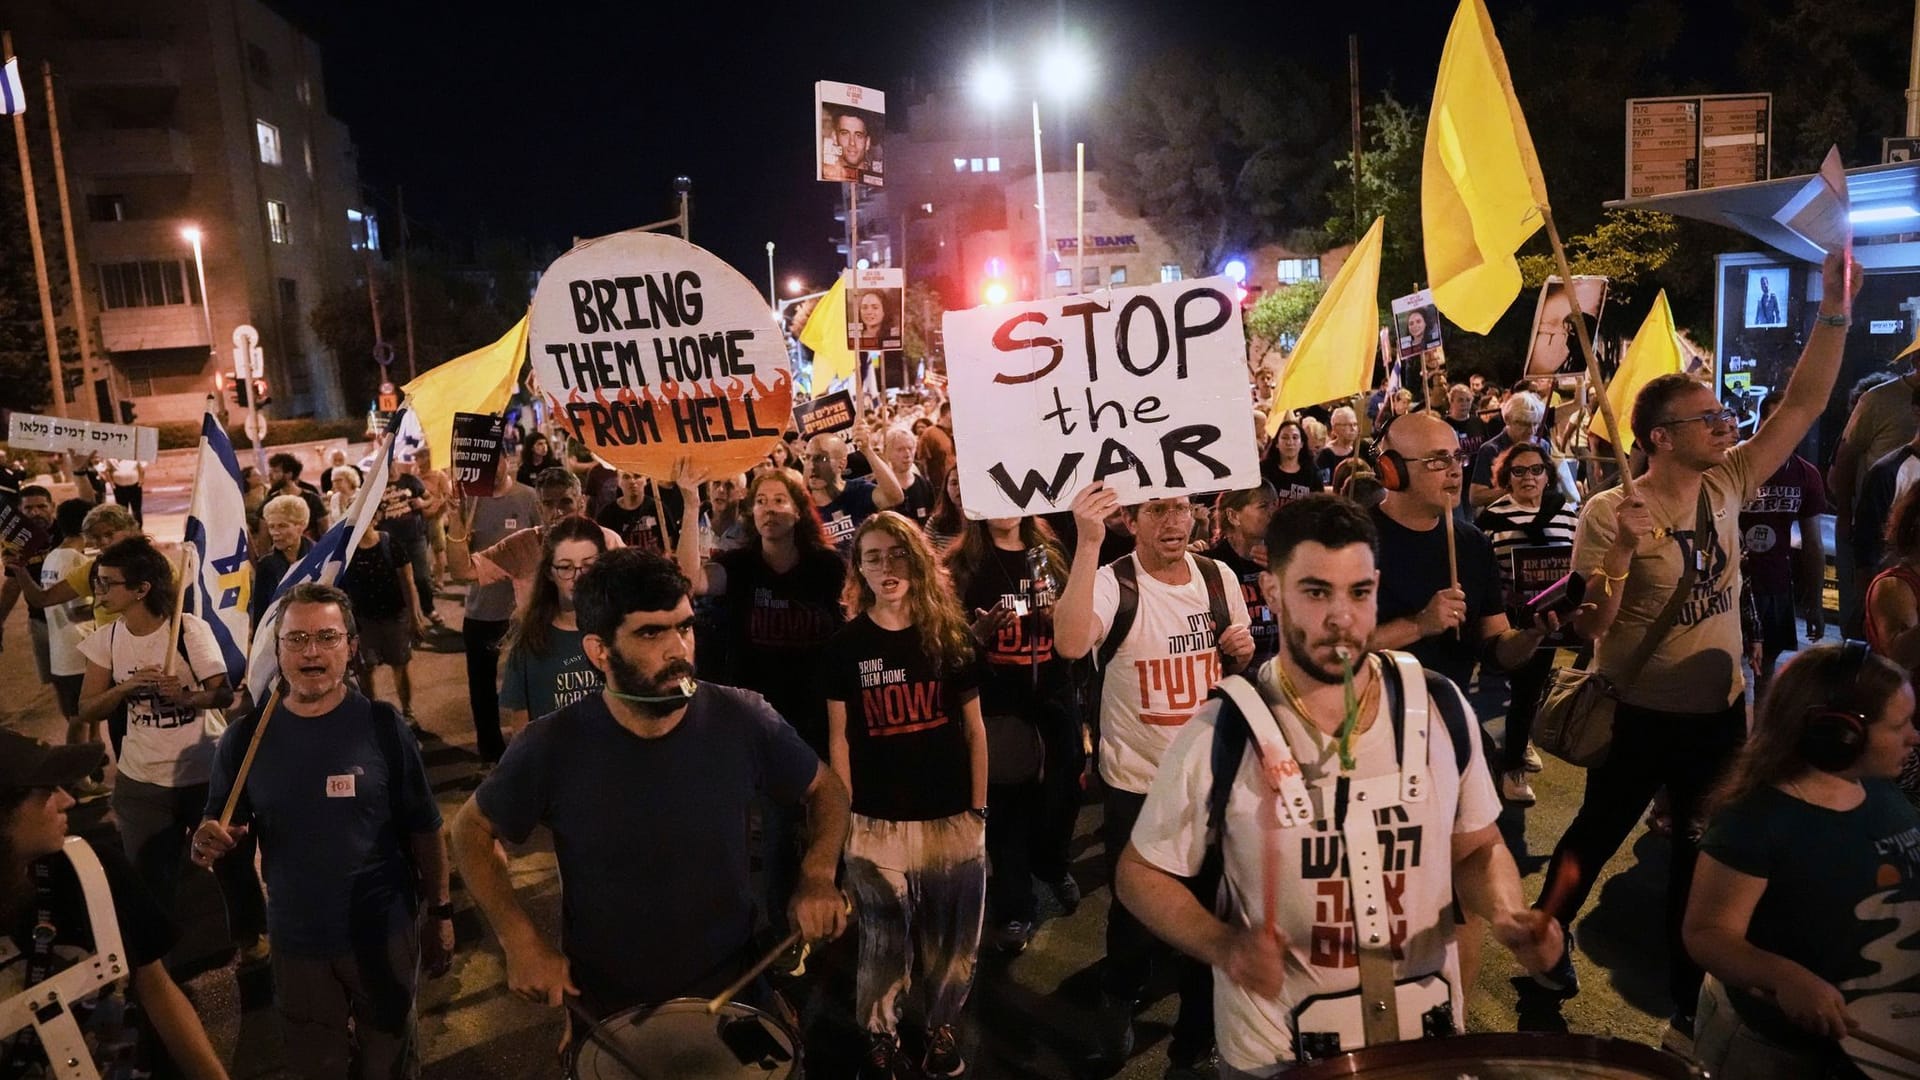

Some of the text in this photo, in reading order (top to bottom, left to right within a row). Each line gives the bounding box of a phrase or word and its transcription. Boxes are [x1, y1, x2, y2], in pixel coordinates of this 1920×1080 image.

[570, 270, 703, 335] BRING
[992, 287, 1234, 384] STOP
[546, 330, 755, 392] THEM HOME
[567, 393, 779, 447] FROM HELL
[1042, 386, 1170, 435] the
[988, 424, 1232, 510] WAR
[562, 654, 583, 666] EASY
[858, 658, 884, 675] BRING
[1168, 631, 1205, 654] הביתה
[860, 668, 907, 688] THEM HOME
[861, 681, 945, 728] NOW!
[1316, 872, 1406, 924] אה
